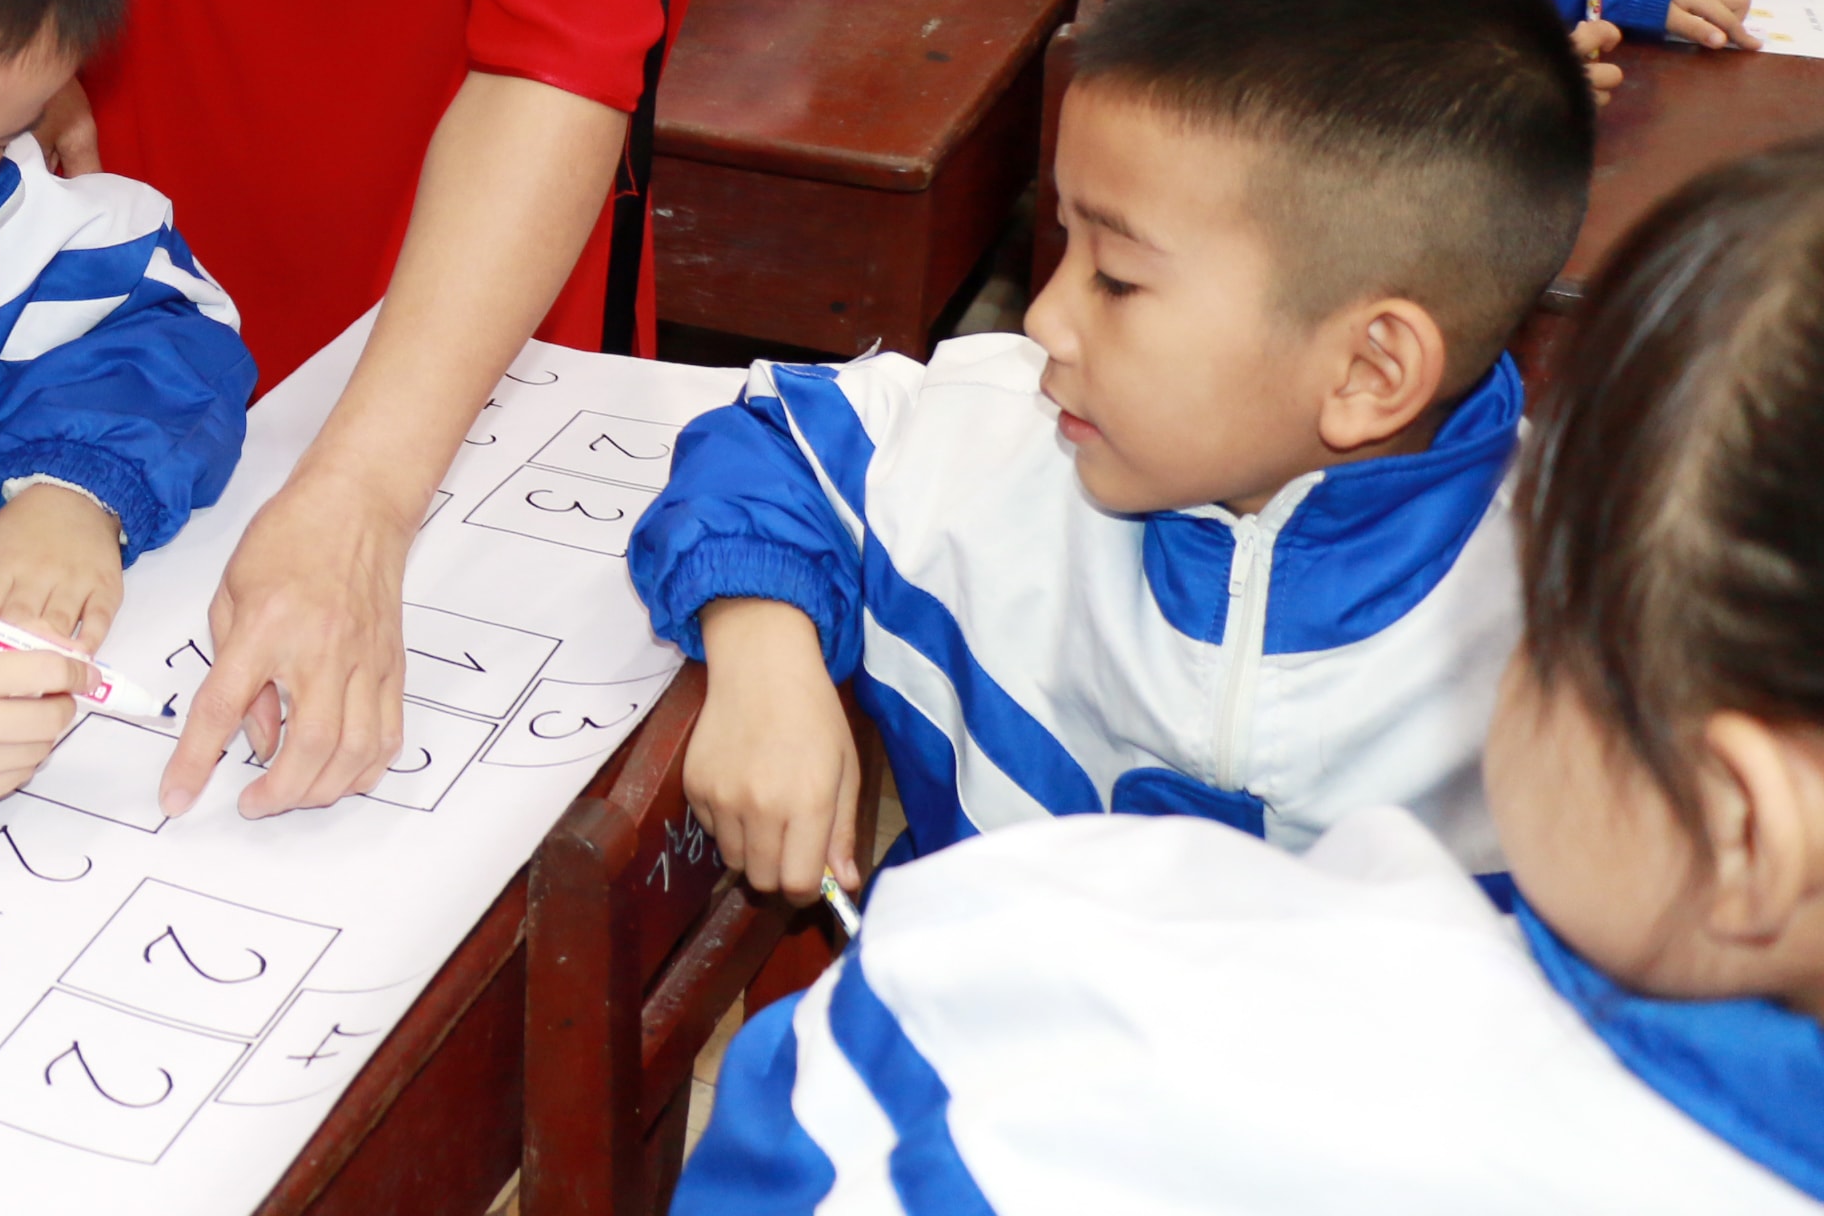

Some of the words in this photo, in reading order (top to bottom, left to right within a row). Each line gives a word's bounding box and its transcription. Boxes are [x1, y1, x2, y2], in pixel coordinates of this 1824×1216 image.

[589, 433, 670, 461] 2
[525, 489, 624, 522] 3
[529, 702, 638, 739] 3
[144, 924, 267, 984] 2
[44, 1040, 173, 1108] 2
